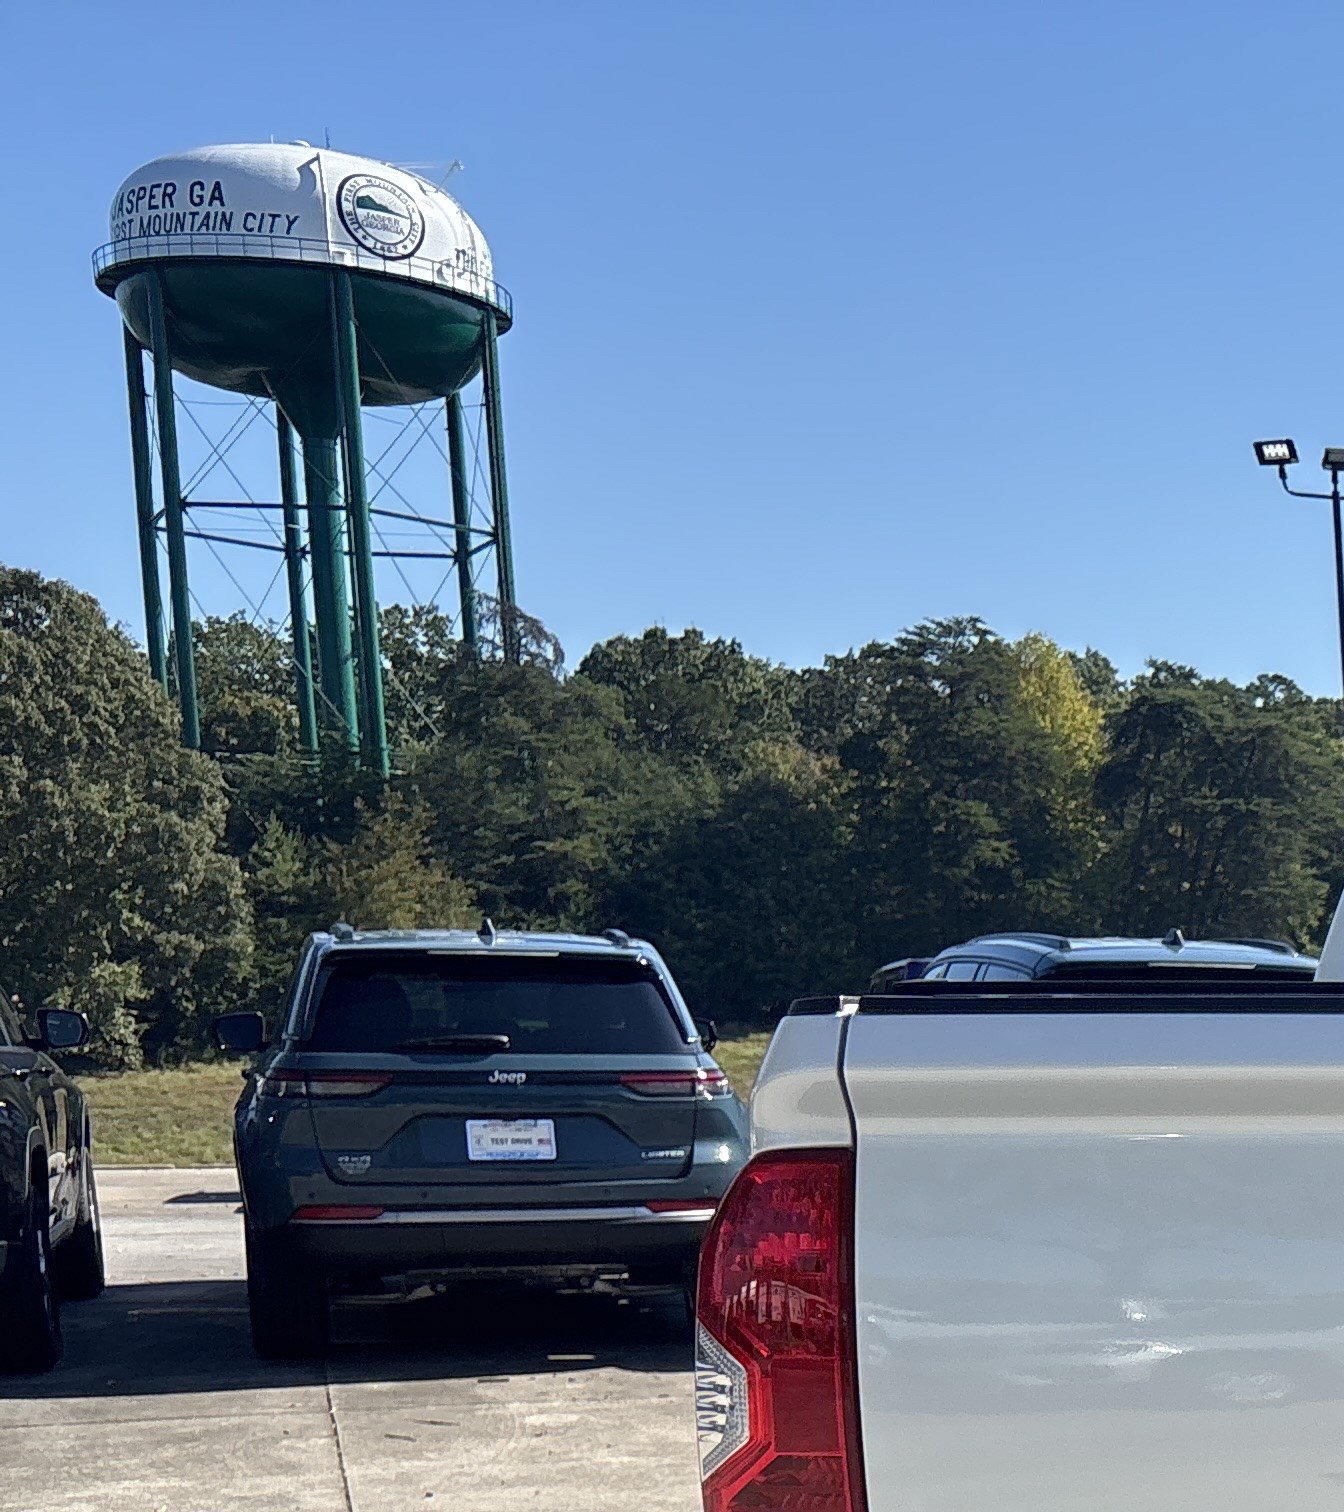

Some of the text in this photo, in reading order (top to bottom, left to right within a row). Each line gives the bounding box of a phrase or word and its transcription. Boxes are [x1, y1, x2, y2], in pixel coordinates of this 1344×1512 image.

[189, 180, 225, 207] GA
[138, 211, 233, 236] MOUNTAIN
[243, 212, 300, 235] CITY
[488, 1070, 527, 1085] Jeep
